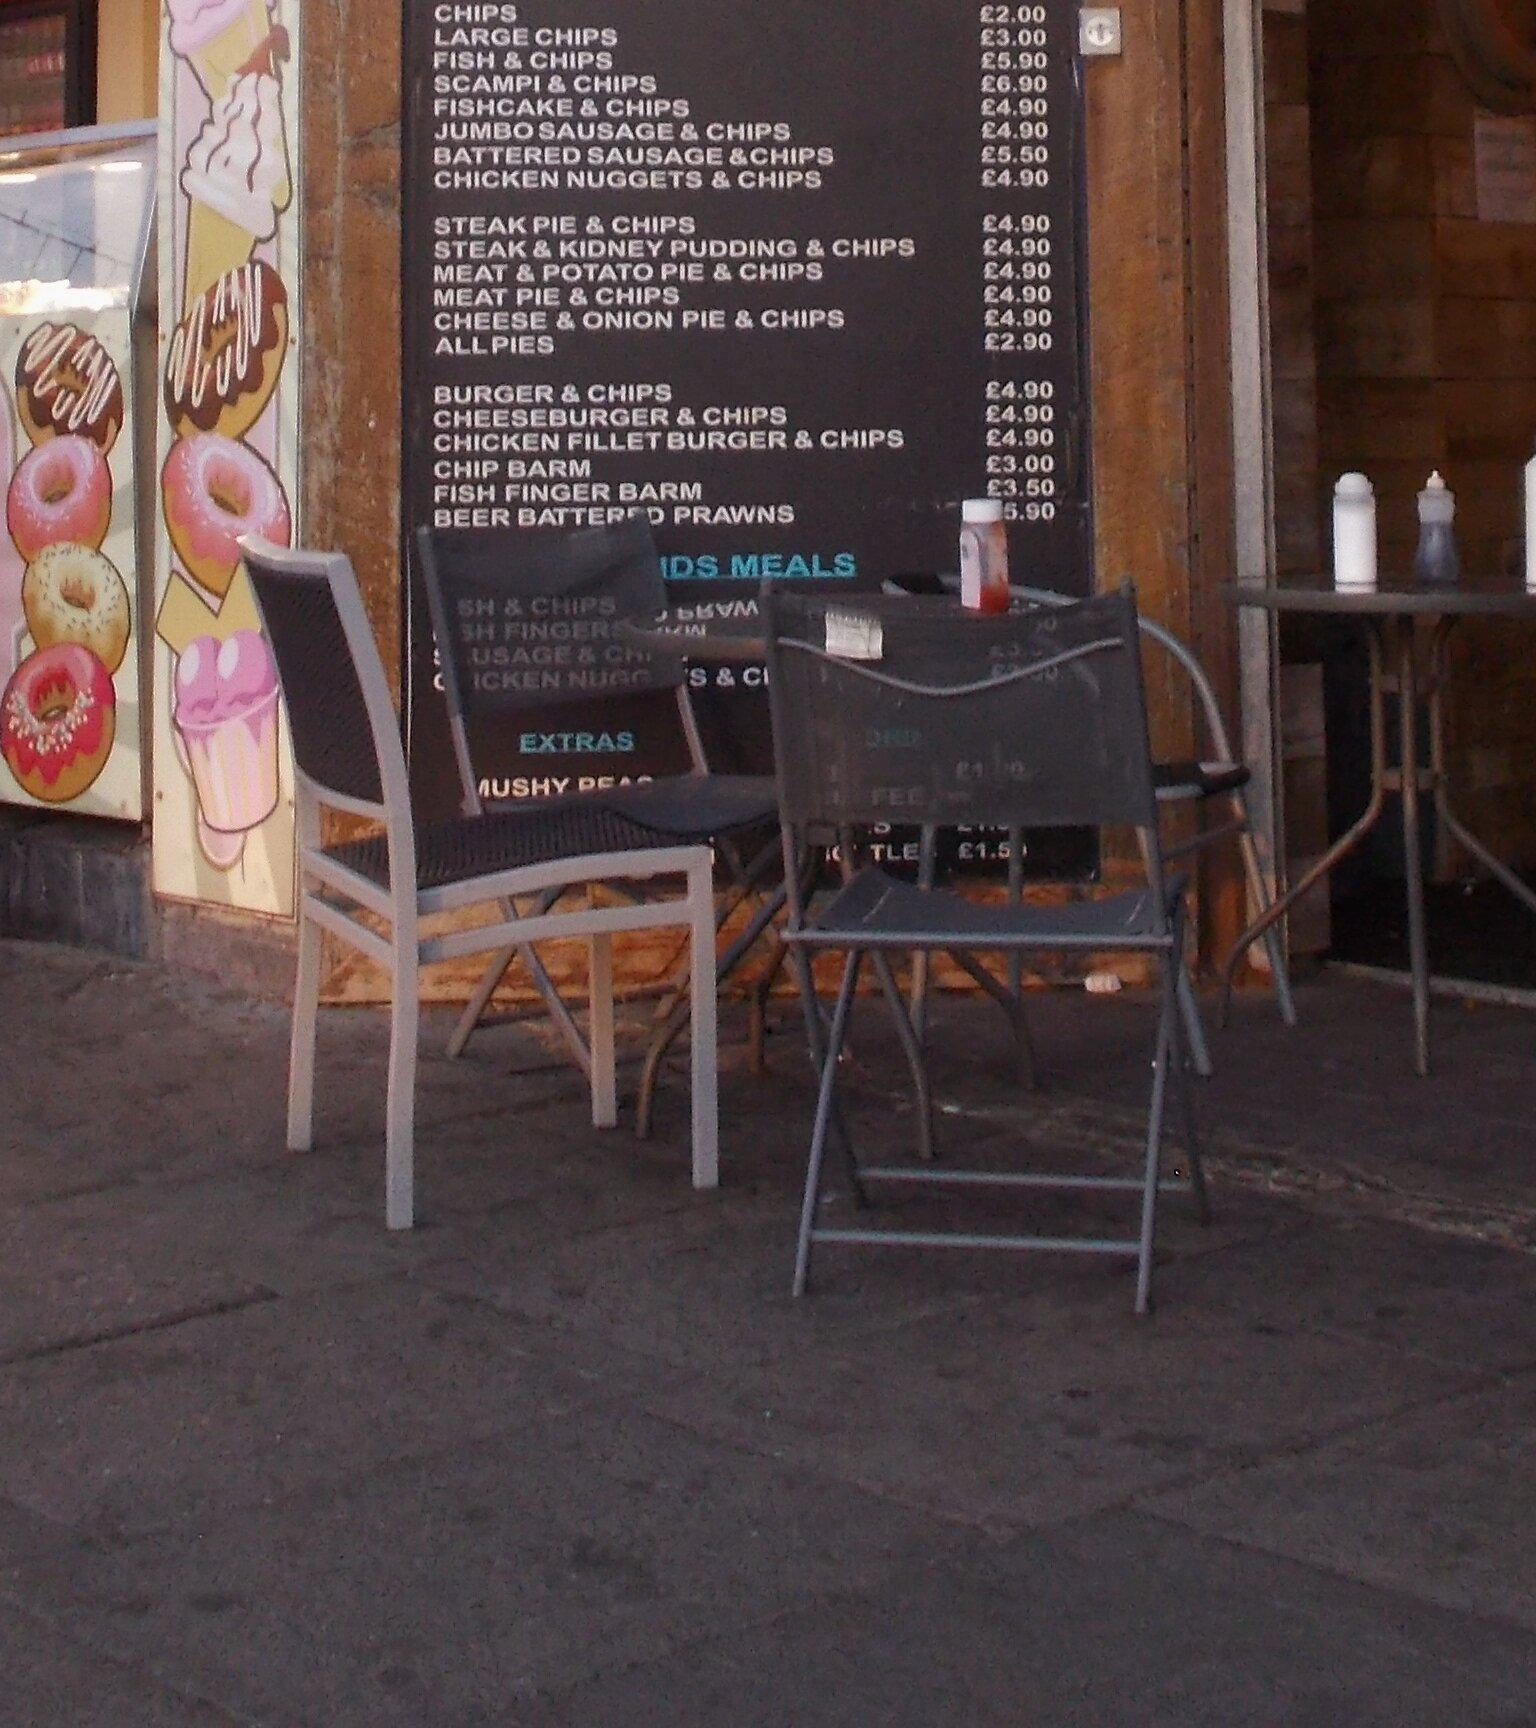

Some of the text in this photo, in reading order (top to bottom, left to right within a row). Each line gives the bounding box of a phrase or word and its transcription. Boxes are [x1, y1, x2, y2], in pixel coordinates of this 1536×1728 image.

[434, 3, 518, 24] CHIPS
[981, 5, 1045, 23] £2.00
[434, 27, 618, 48] LARGE CHIPS
[981, 29, 1046, 46] £3.00
[433, 50, 613, 71] FISH & CHIPS
[982, 52, 1047, 69] £5.90
[434, 74, 657, 95] SCAMPI & CHIPS
[981, 75, 1047, 93] £6.90
[433, 97, 690, 118] FISHCAKE & CHIPS
[981, 98, 1047, 116] £4.90
[434, 121, 791, 142] JUMBO SAUSAGE & CHIPS
[982, 122, 1048, 139] £4.90
[433, 145, 582, 166] BATTERED
[587, 146, 724, 167] SAUSAGE
[982, 146, 1048, 163] £5.50
[433, 169, 822, 190] CHICKEN NUGGETS & CHIPS
[982, 169, 1049, 186] £4.90
[434, 215, 696, 236] STEAK PIE & CHIPS
[983, 215, 1049, 232] £4.90
[434, 238, 915, 260] STEAK & KIDNEY PUDDING & CHIPS
[983, 238, 1050, 256] £4.90
[433, 261, 823, 283] MEAT & POTATO PIE & CHIPS
[984, 262, 1050, 279] £4.90
[433, 286, 680, 307] MEAT PIE & CHIPS
[984, 285, 1051, 303] £4.90
[434, 309, 845, 332] CHEESE & ONION PIE & CHIPS
[985, 309, 1051, 326] £4.90
[434, 335, 555, 355] ALL PIES
[985, 333, 1051, 350] £2.90
[434, 383, 672, 405] BURGER & CHIPS
[986, 381, 1053, 399] £4.90
[433, 406, 787, 429] CHEESEBURGER & CHIPS
[986, 405, 1053, 422] £4.90
[433, 429, 904, 453] CHICKEN FILLET BURGER & CHIPS
[987, 429, 1053, 446] £4.90
[433, 459, 591, 480] CHIP BARM
[987, 455, 1053, 472] £3.00
[434, 482, 702, 504] FISH FINGER BARM
[987, 479, 1054, 496] £3.50
[434, 508, 510, 527] BEER
[673, 504, 795, 524] PRAWNS
[1004, 502, 1055, 521] 5.90
[659, 552, 857, 579] IDS MEALS
[531, 597, 617, 616] CHIPS
[432, 668, 562, 692] CICKEN
[517, 730, 635, 754] EXTRAS
[478, 776, 571, 799] MUSHY
[958, 842, 1028, 860] £1.5
